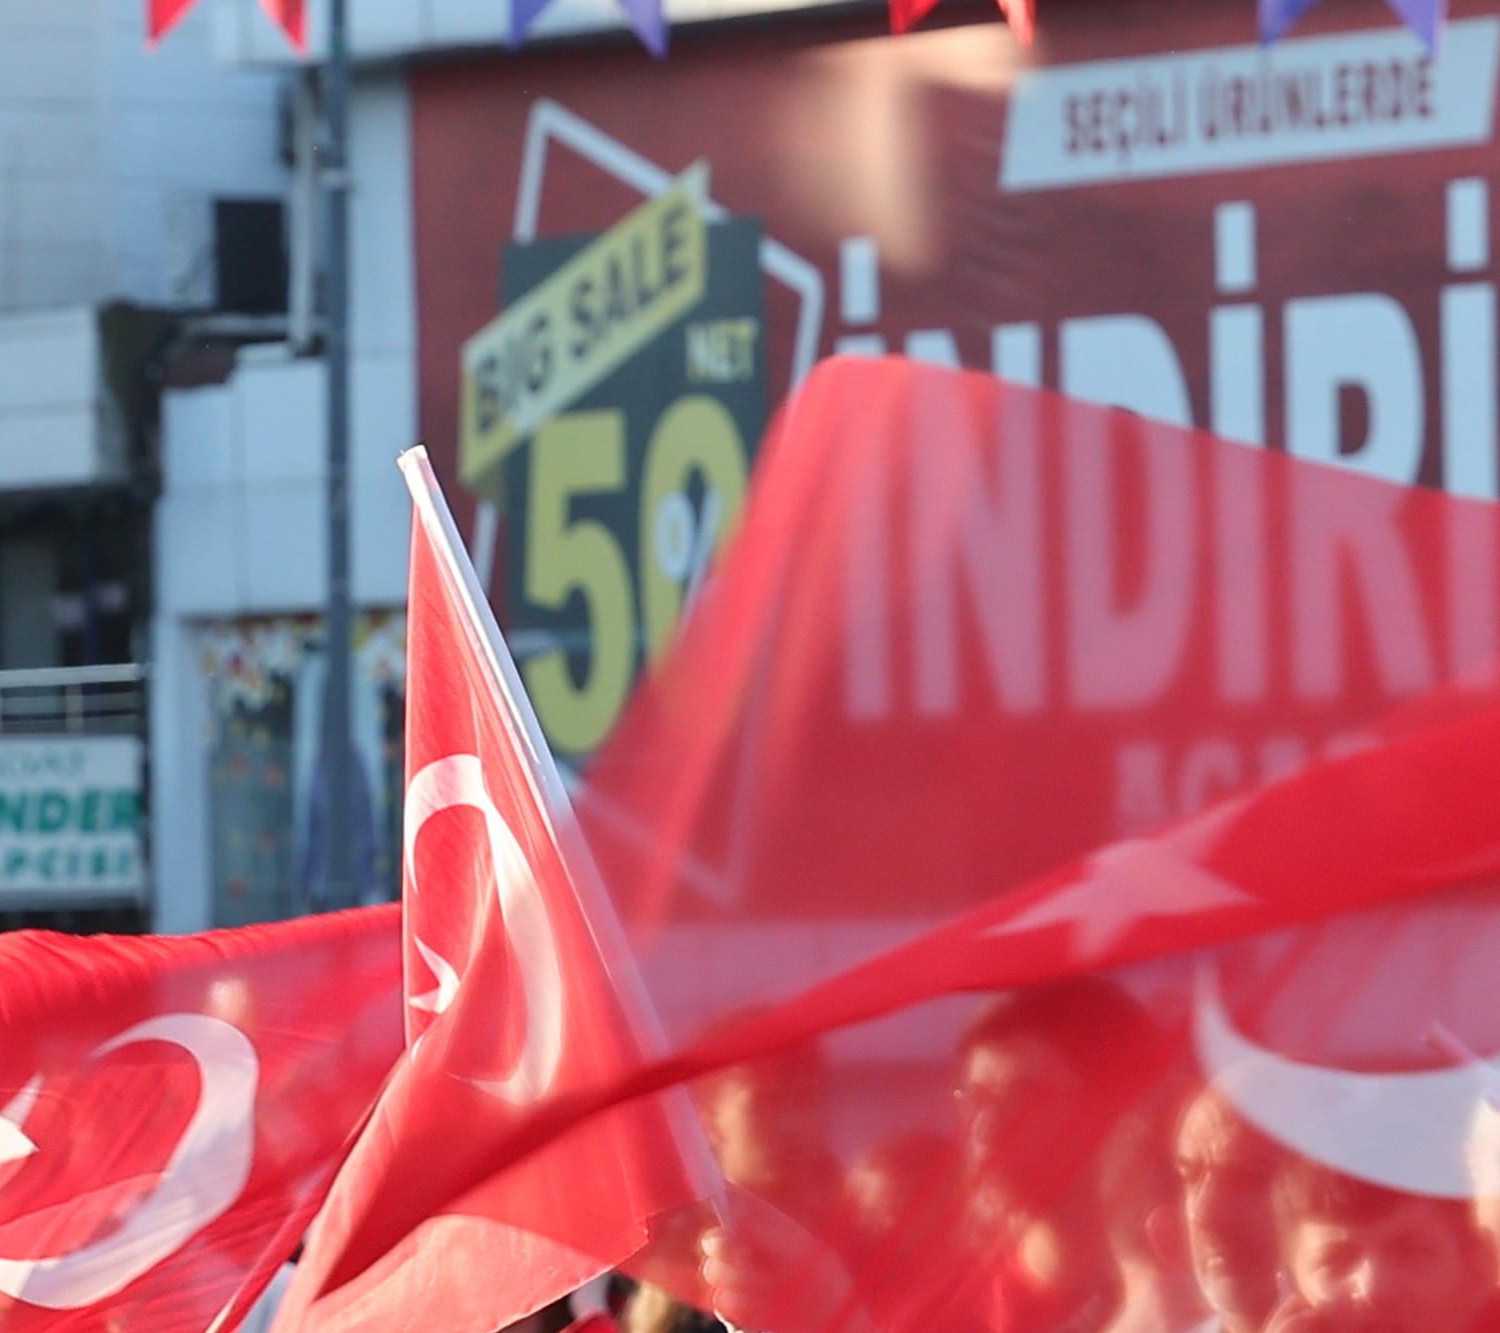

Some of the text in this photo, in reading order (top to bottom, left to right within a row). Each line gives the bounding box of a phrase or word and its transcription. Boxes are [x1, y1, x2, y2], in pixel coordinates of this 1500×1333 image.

[1066, 52, 1436, 172] SEÇİLİ ÜRÜNLERDE
[476, 205, 688, 437] BIG SALE
[687, 317, 758, 382] NET
